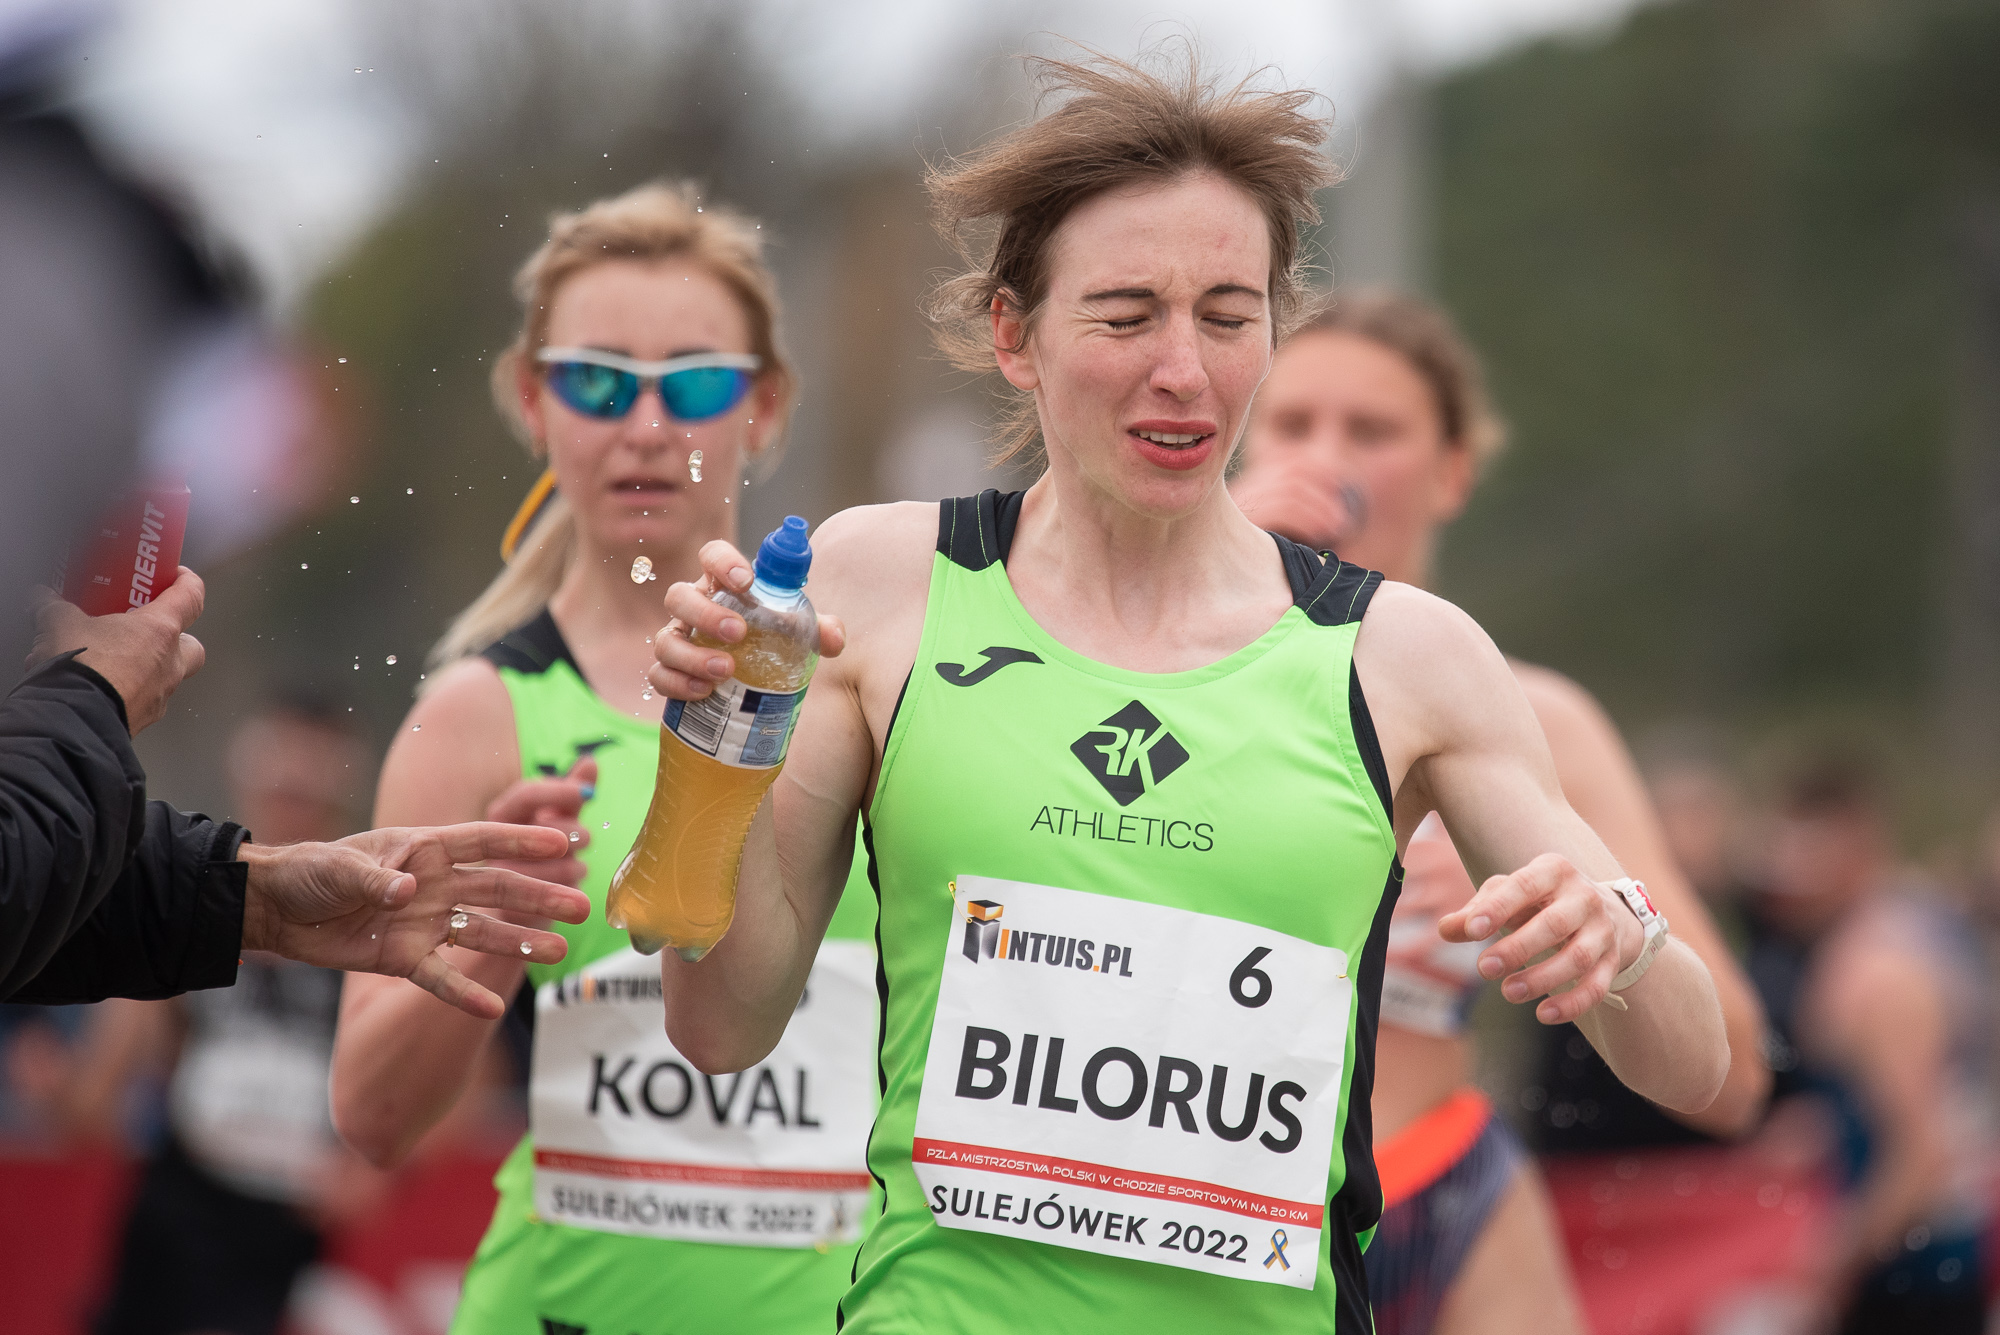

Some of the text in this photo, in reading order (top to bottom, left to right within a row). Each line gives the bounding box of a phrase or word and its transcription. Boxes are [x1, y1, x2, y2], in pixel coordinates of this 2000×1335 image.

[128, 500, 165, 609] ENERVIT
[1030, 805, 1214, 852] ATHLETICS
[998, 929, 1133, 978] INTUIS.PL
[1228, 946, 1273, 1008] 6
[587, 1053, 822, 1129] KOVAL
[954, 1025, 1307, 1154] BILORUS
[552, 1185, 731, 1231] SULEJÓWEK
[926, 1148, 1308, 1221] PZLA MISTRZOSTWA POLSKI W CHODZIE SPORTOWYM NA 20 KM
[930, 1185, 1248, 1263] SULEJÓWEK 2022
